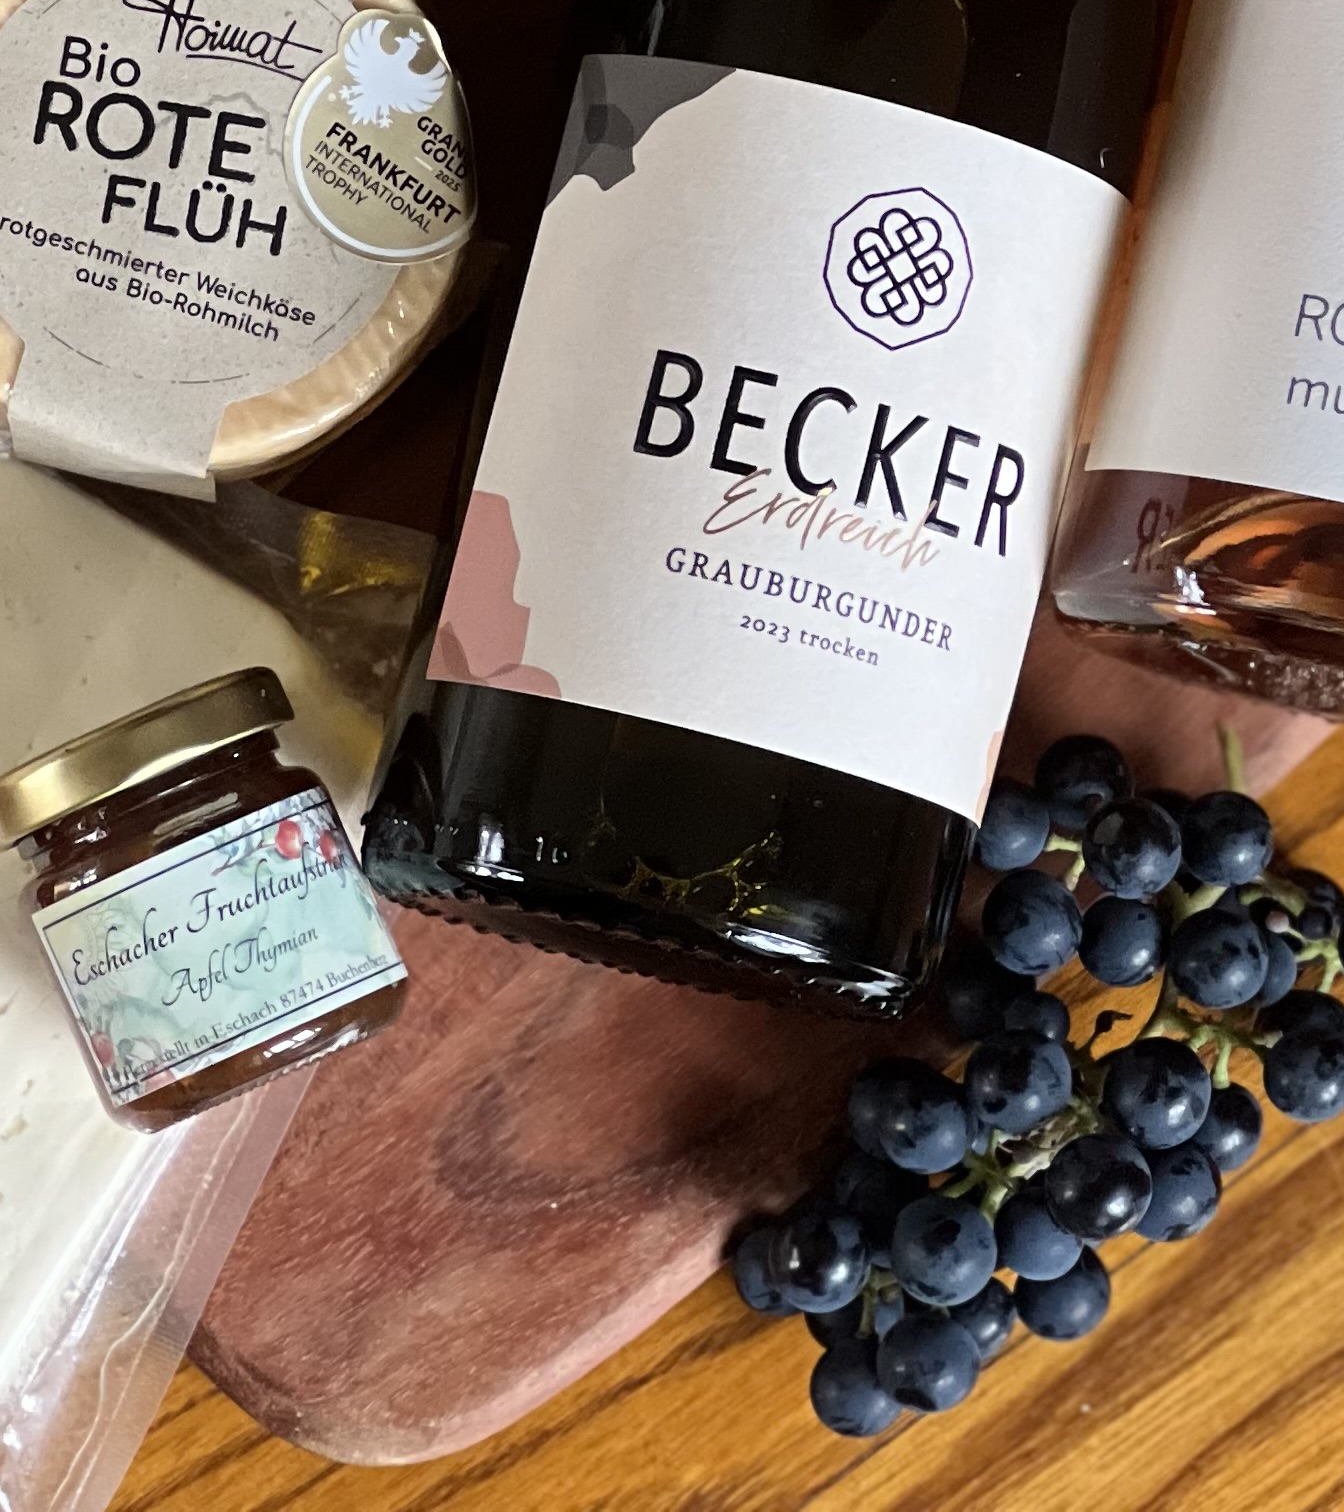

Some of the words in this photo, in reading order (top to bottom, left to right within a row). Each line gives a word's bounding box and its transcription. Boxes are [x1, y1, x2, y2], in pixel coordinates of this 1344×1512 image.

[59, 34, 141, 88] Bio
[33, 80, 266, 184] ROTE
[417, 116, 465, 159] GRAN
[421, 139, 468, 180] GOLD
[305, 154, 369, 206] TROPHY
[314, 140, 433, 234] INTERNATIONAL
[325, 121, 462, 225] FRANKFURT
[100, 174, 288, 256] FLÜH
[74, 264, 119, 294] aus
[126, 277, 280, 343] Bio-Rohmilch
[196, 271, 317, 328] Weichkäse
[632, 348, 1026, 558] BECKER
[702, 467, 943, 571] Erdreich
[664, 546, 954, 652] GRAUBURGUNDER
[739, 614, 792, 646] 2023
[798, 626, 881, 668] trocken
[72, 906, 180, 986] Eschacher
[161, 942, 232, 1007] Apfel
[234, 926, 319, 973] Thymian
[194, 1031, 210, 1049] in
[211, 1000, 280, 1041] Eschach
[280, 979, 325, 1009] 87474
